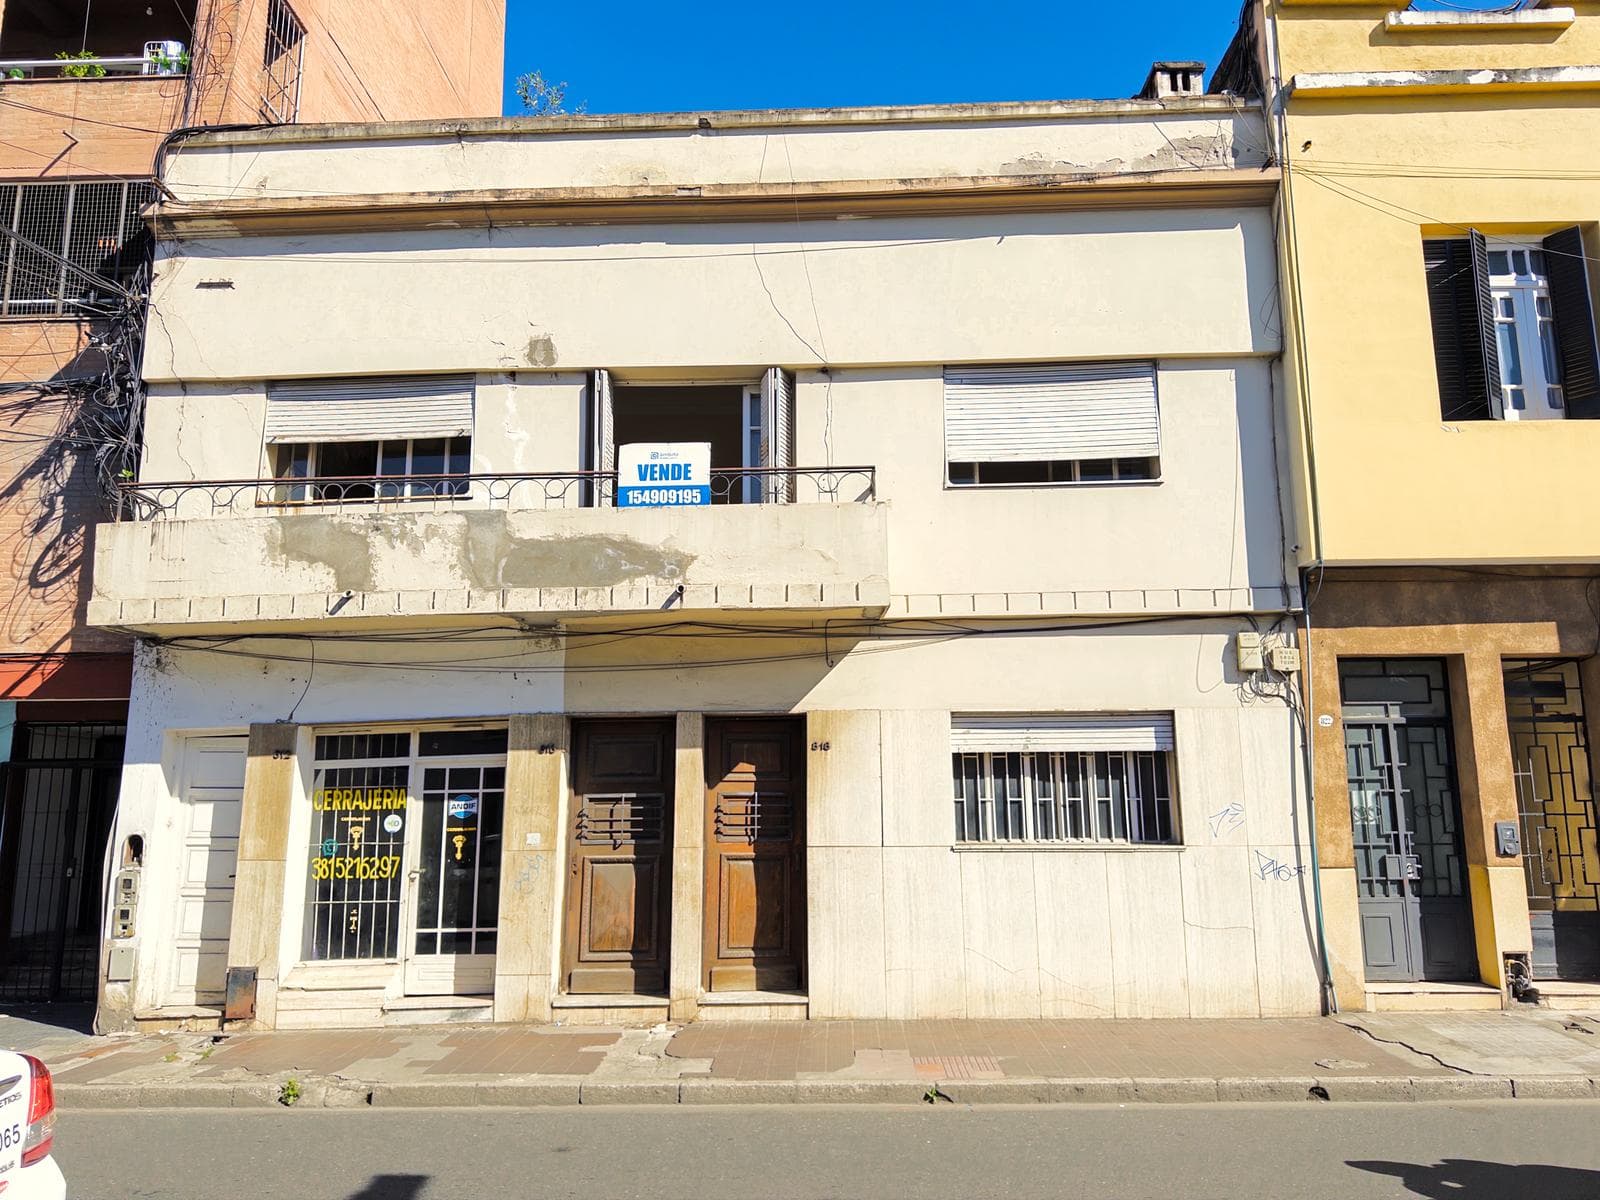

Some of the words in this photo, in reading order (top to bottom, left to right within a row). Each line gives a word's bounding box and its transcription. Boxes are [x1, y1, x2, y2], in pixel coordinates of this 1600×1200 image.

[637, 463, 692, 481] VENDE
[627, 489, 701, 505] 154909195
[313, 789, 407, 811] CERRAJERIA
[451, 802, 477, 811] ANDIF
[311, 856, 400, 880] 3815216297
